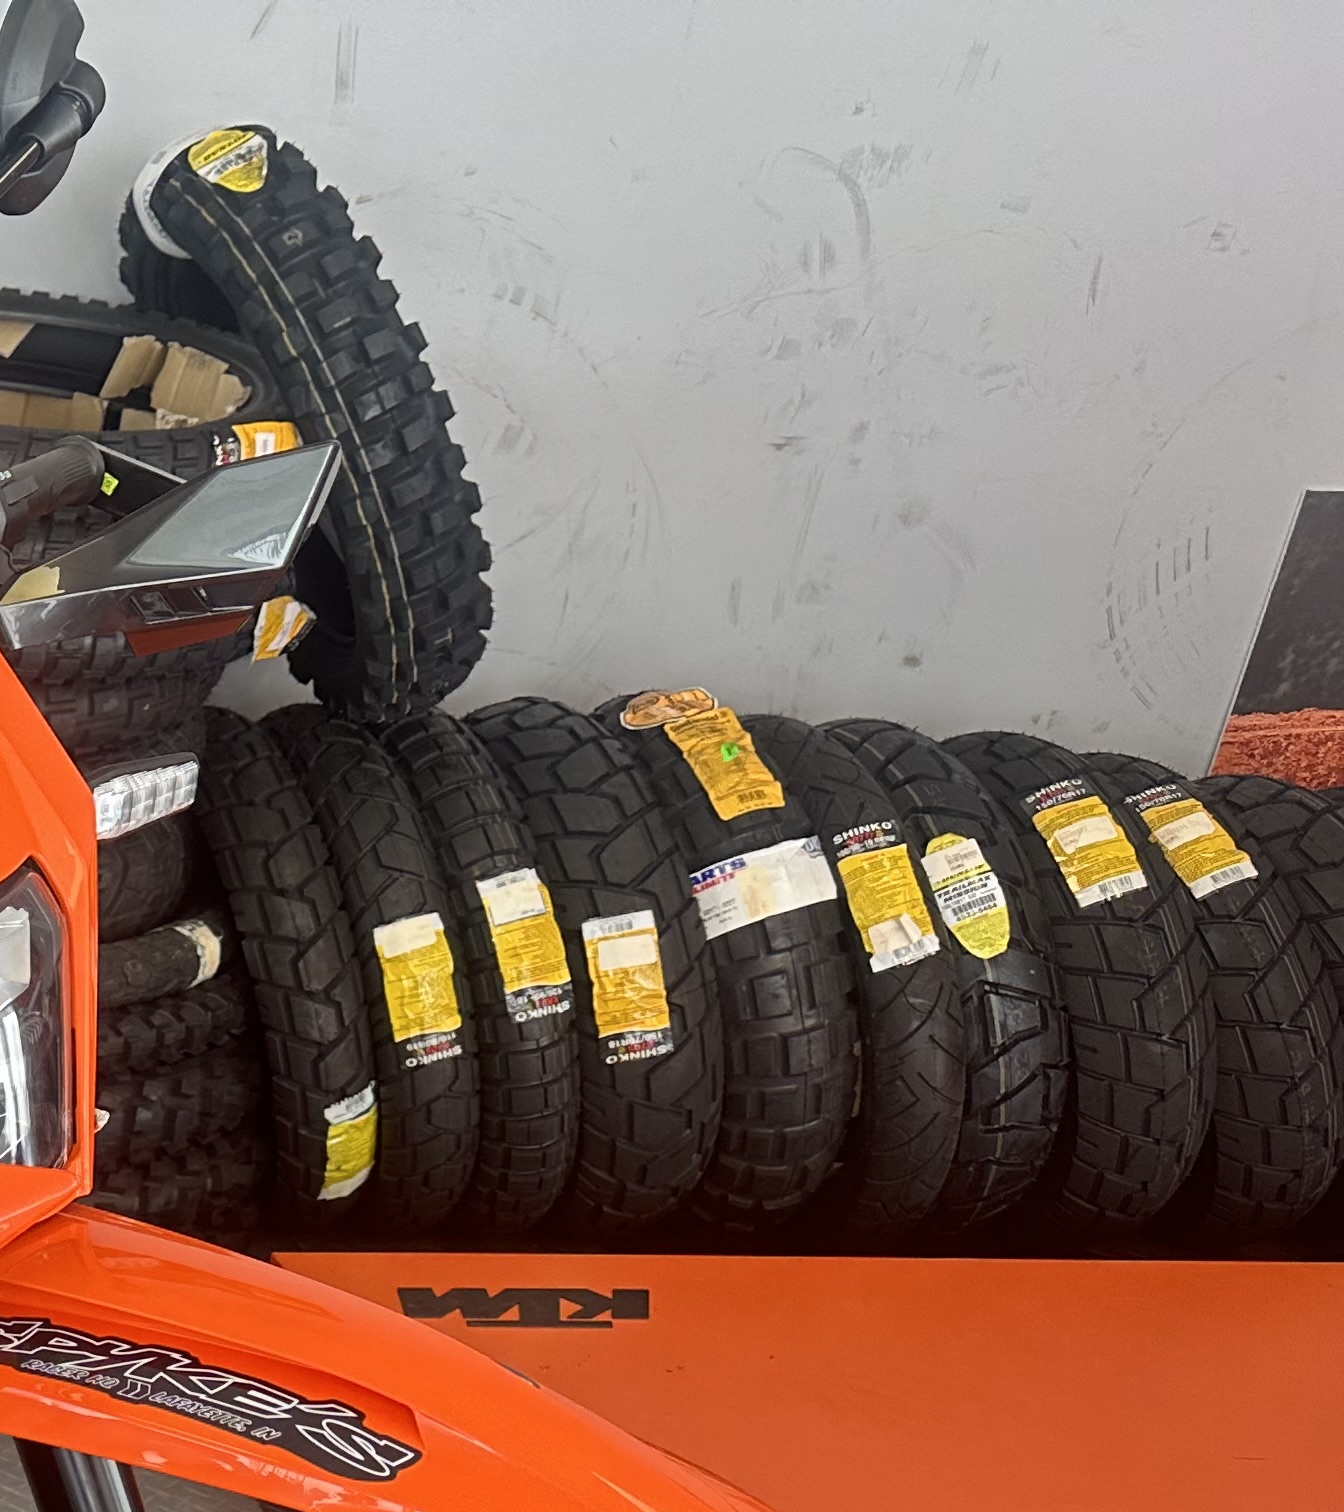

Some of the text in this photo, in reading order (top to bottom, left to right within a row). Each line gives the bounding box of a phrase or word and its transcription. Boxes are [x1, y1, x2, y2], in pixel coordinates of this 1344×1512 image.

[1026, 779, 1082, 803] SHINKO
[1123, 784, 1177, 804] SHINKO
[833, 820, 893, 845] SHINKO
[936, 874, 991, 899] TRAILMAX
[515, 1000, 570, 1023] SHINKO
[405, 1044, 462, 1068] SHINKO
[605, 1044, 669, 1065] SHINKO
[397, 1287, 650, 1328] KTM
[20, 1358, 89, 1382] RACER
[250, 1424, 282, 1442] IN
